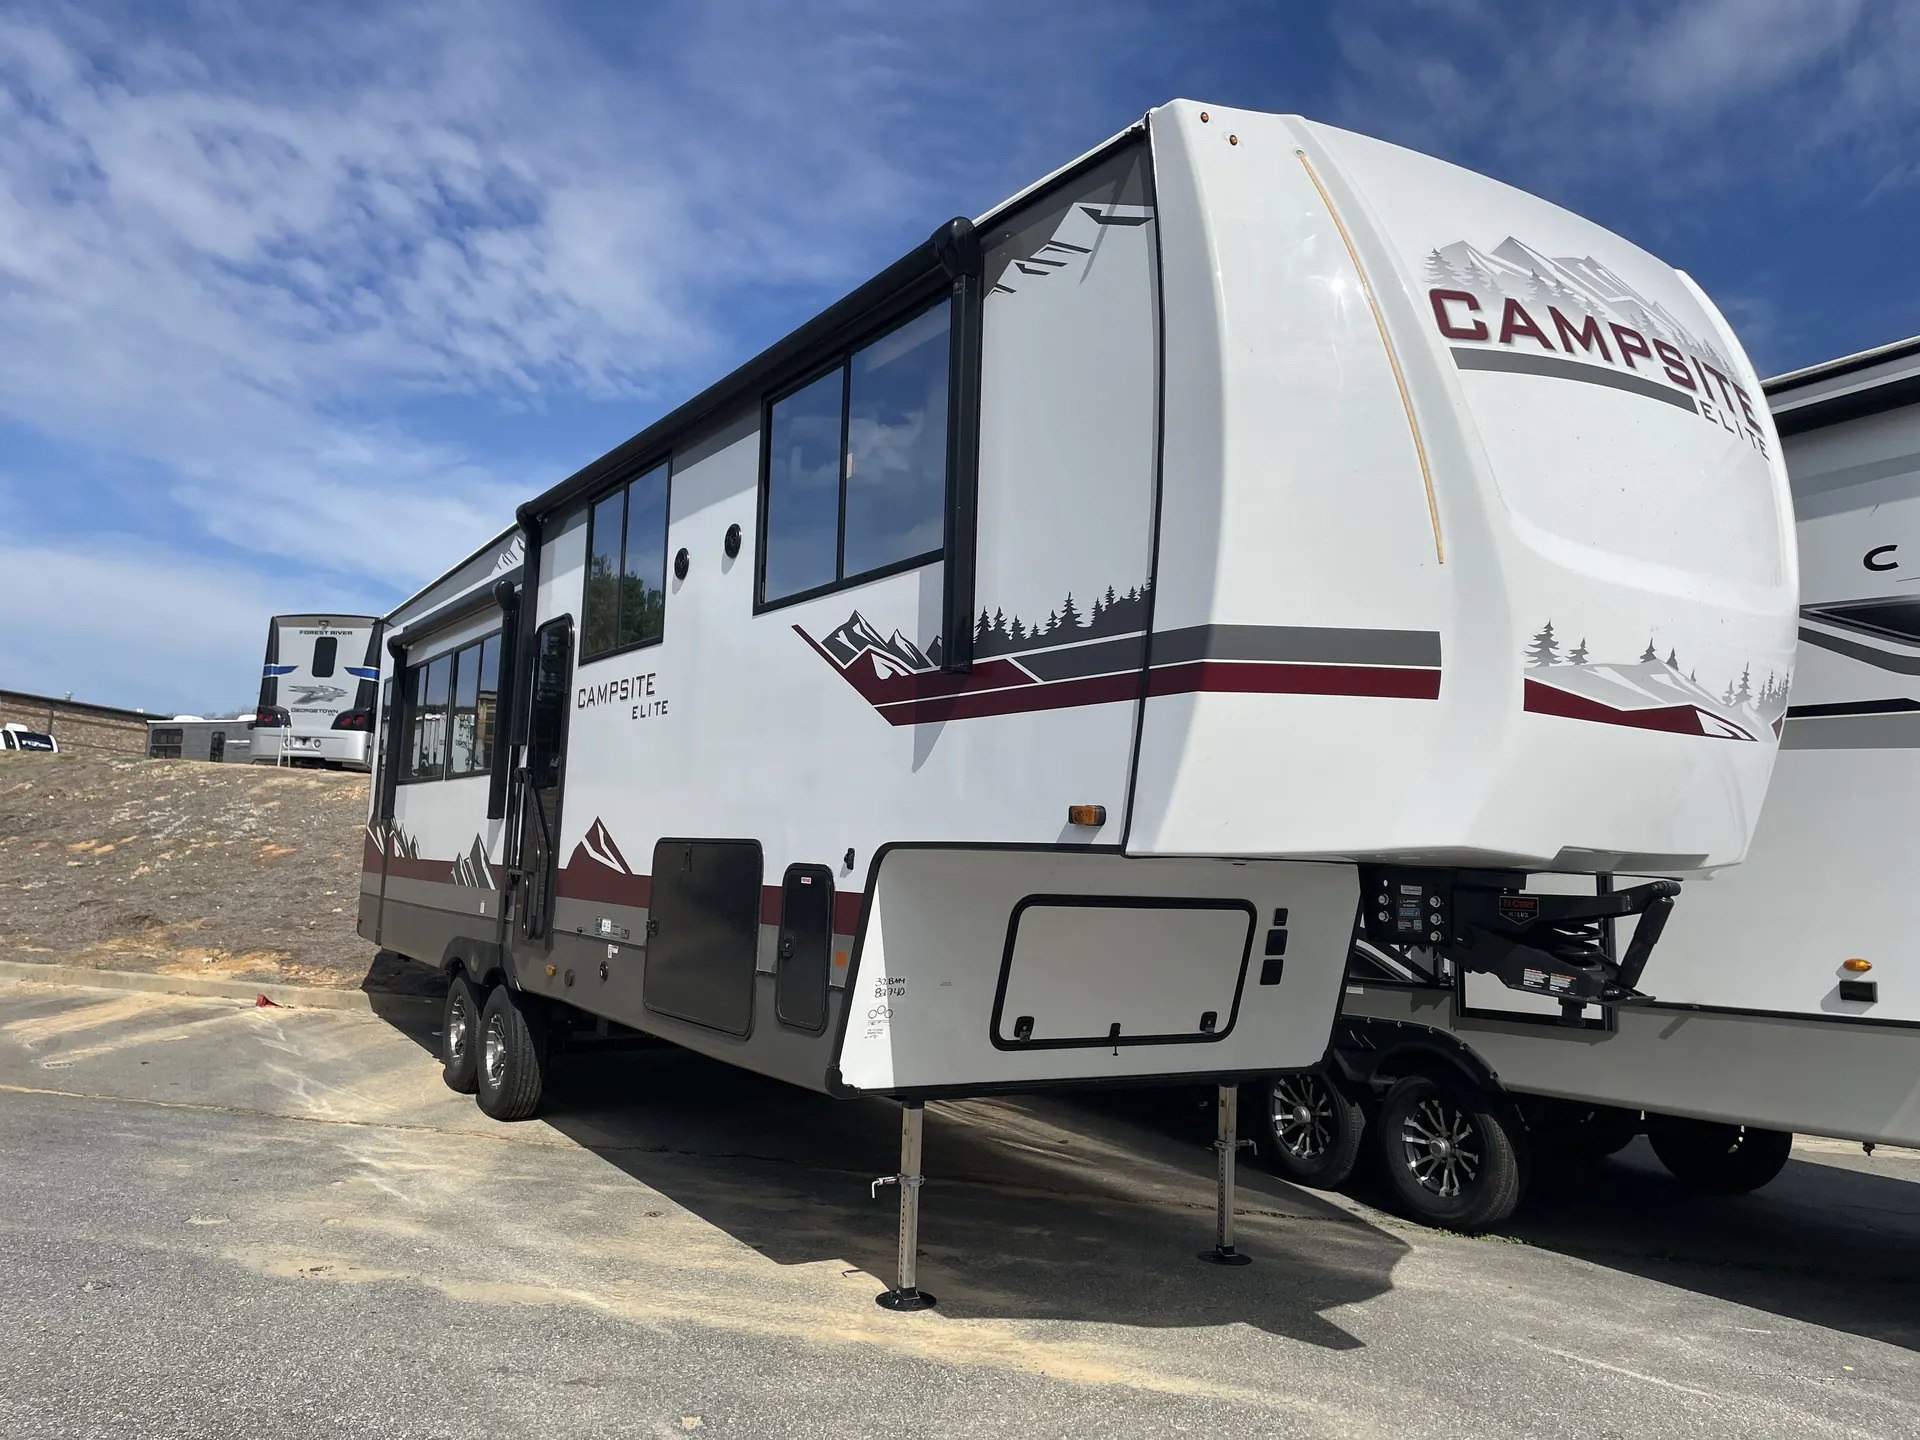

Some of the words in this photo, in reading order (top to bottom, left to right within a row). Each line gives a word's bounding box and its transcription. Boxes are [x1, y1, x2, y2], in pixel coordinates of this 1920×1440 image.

[1428, 287, 1765, 438] CAMPSITE
[1699, 399, 1771, 462] ELITE
[578, 672, 656, 709] CAMPSITE
[631, 699, 668, 720] ELITE
